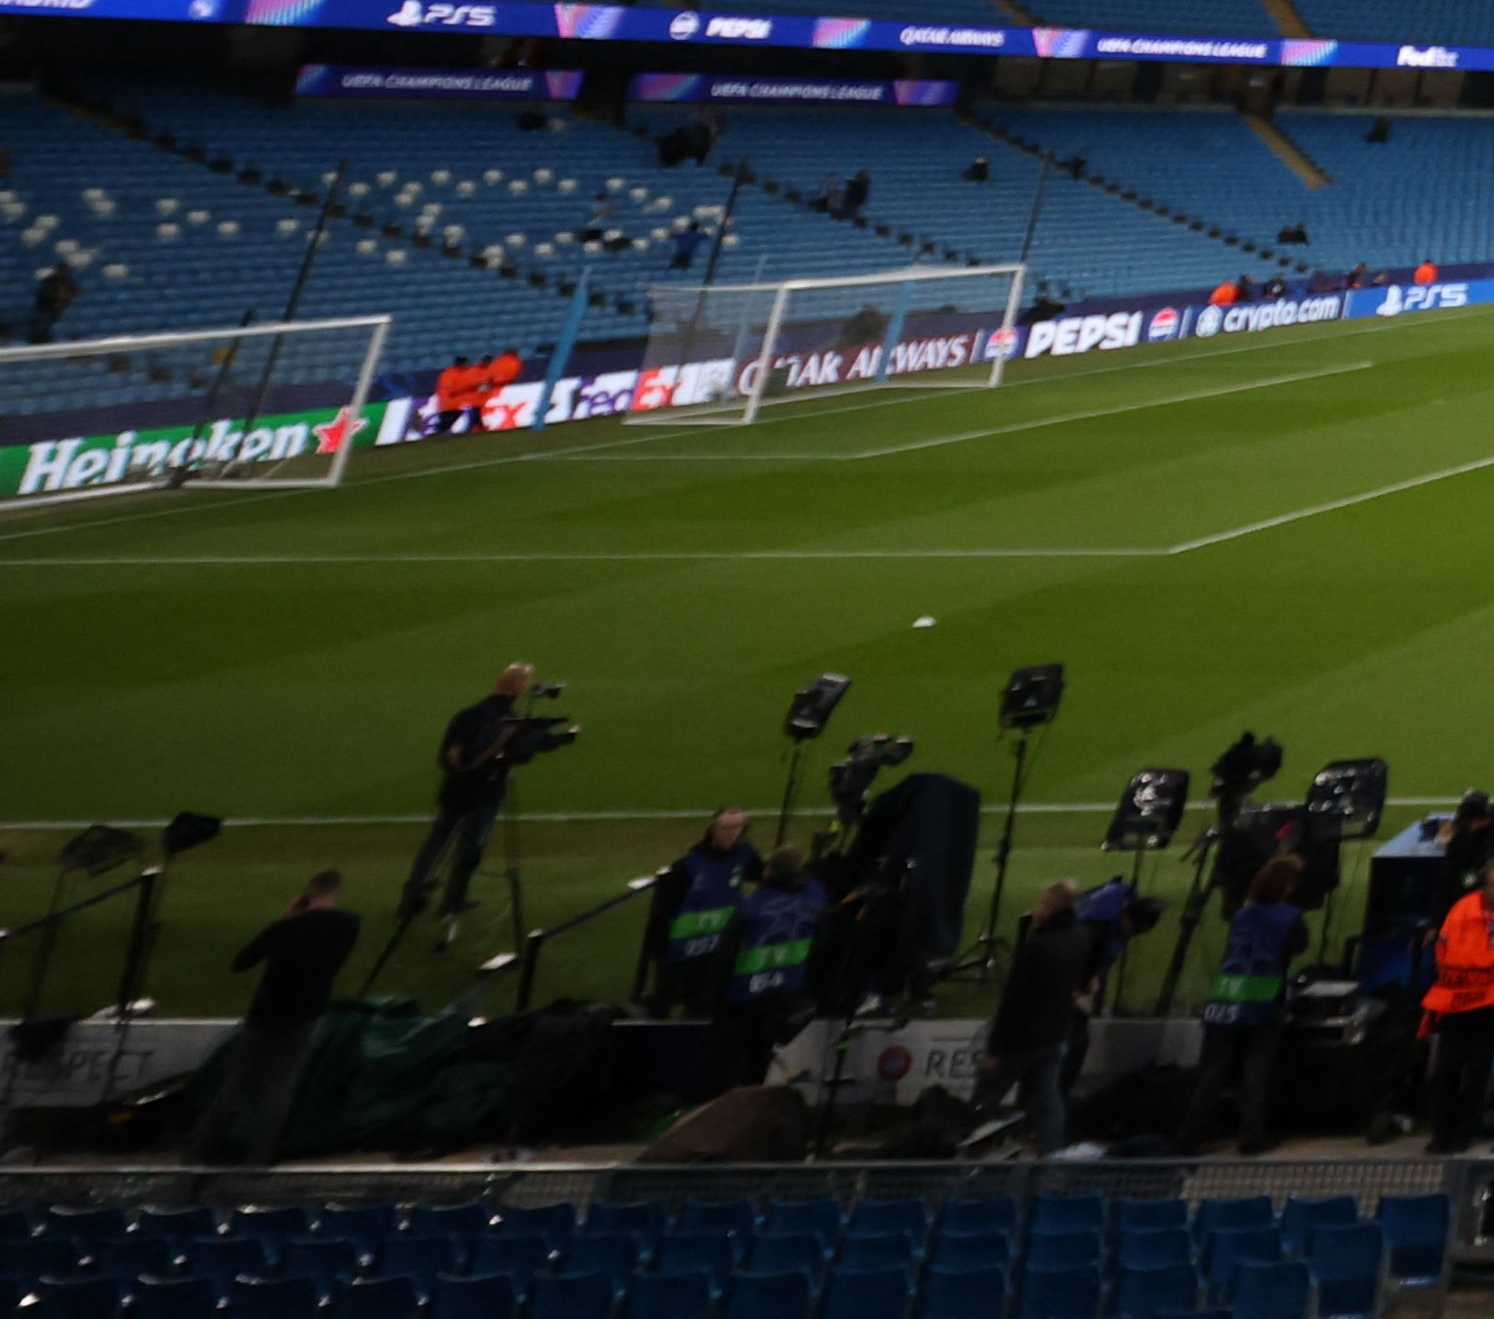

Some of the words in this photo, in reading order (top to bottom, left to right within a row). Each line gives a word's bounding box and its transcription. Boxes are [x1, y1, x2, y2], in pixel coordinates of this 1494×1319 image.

[1223, 294, 1341, 334] crypto.com
[1403, 283, 1469, 309] PS5
[1024, 311, 1144, 359] PEPSI
